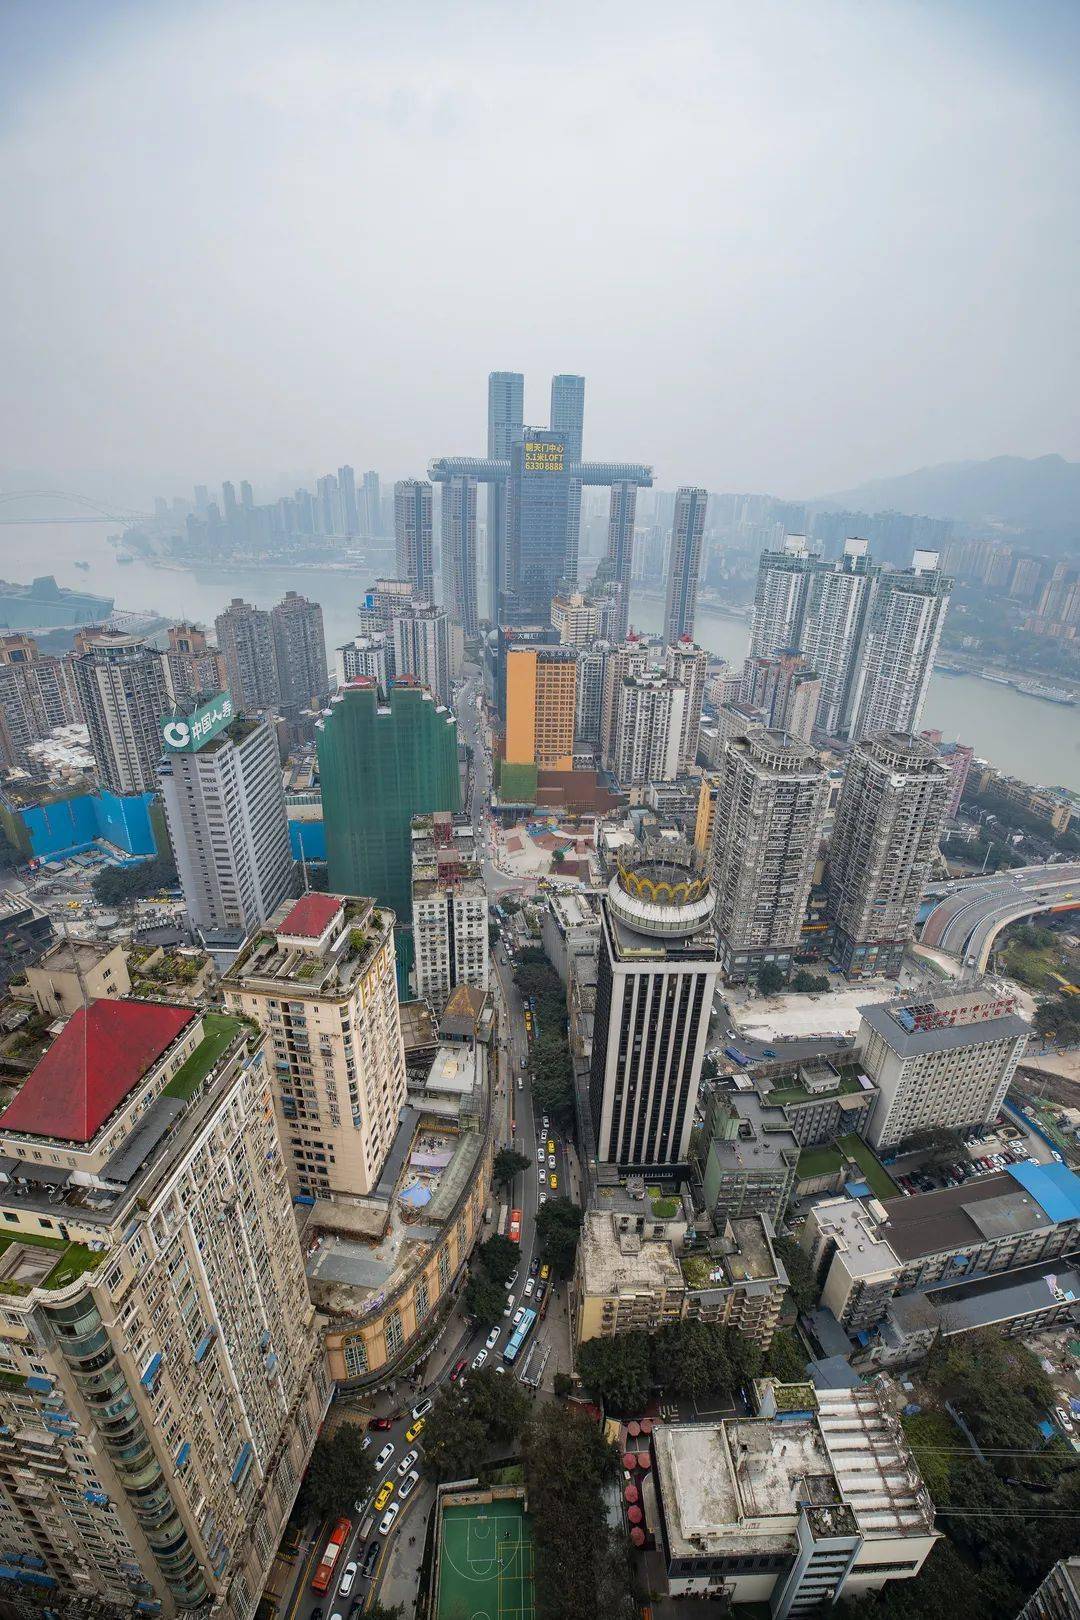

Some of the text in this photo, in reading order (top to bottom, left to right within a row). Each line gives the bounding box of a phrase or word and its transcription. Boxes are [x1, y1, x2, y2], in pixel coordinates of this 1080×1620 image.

[525, 453, 564, 462] 5.1米LOFT
[191, 700, 232, 741] 中国人寿
